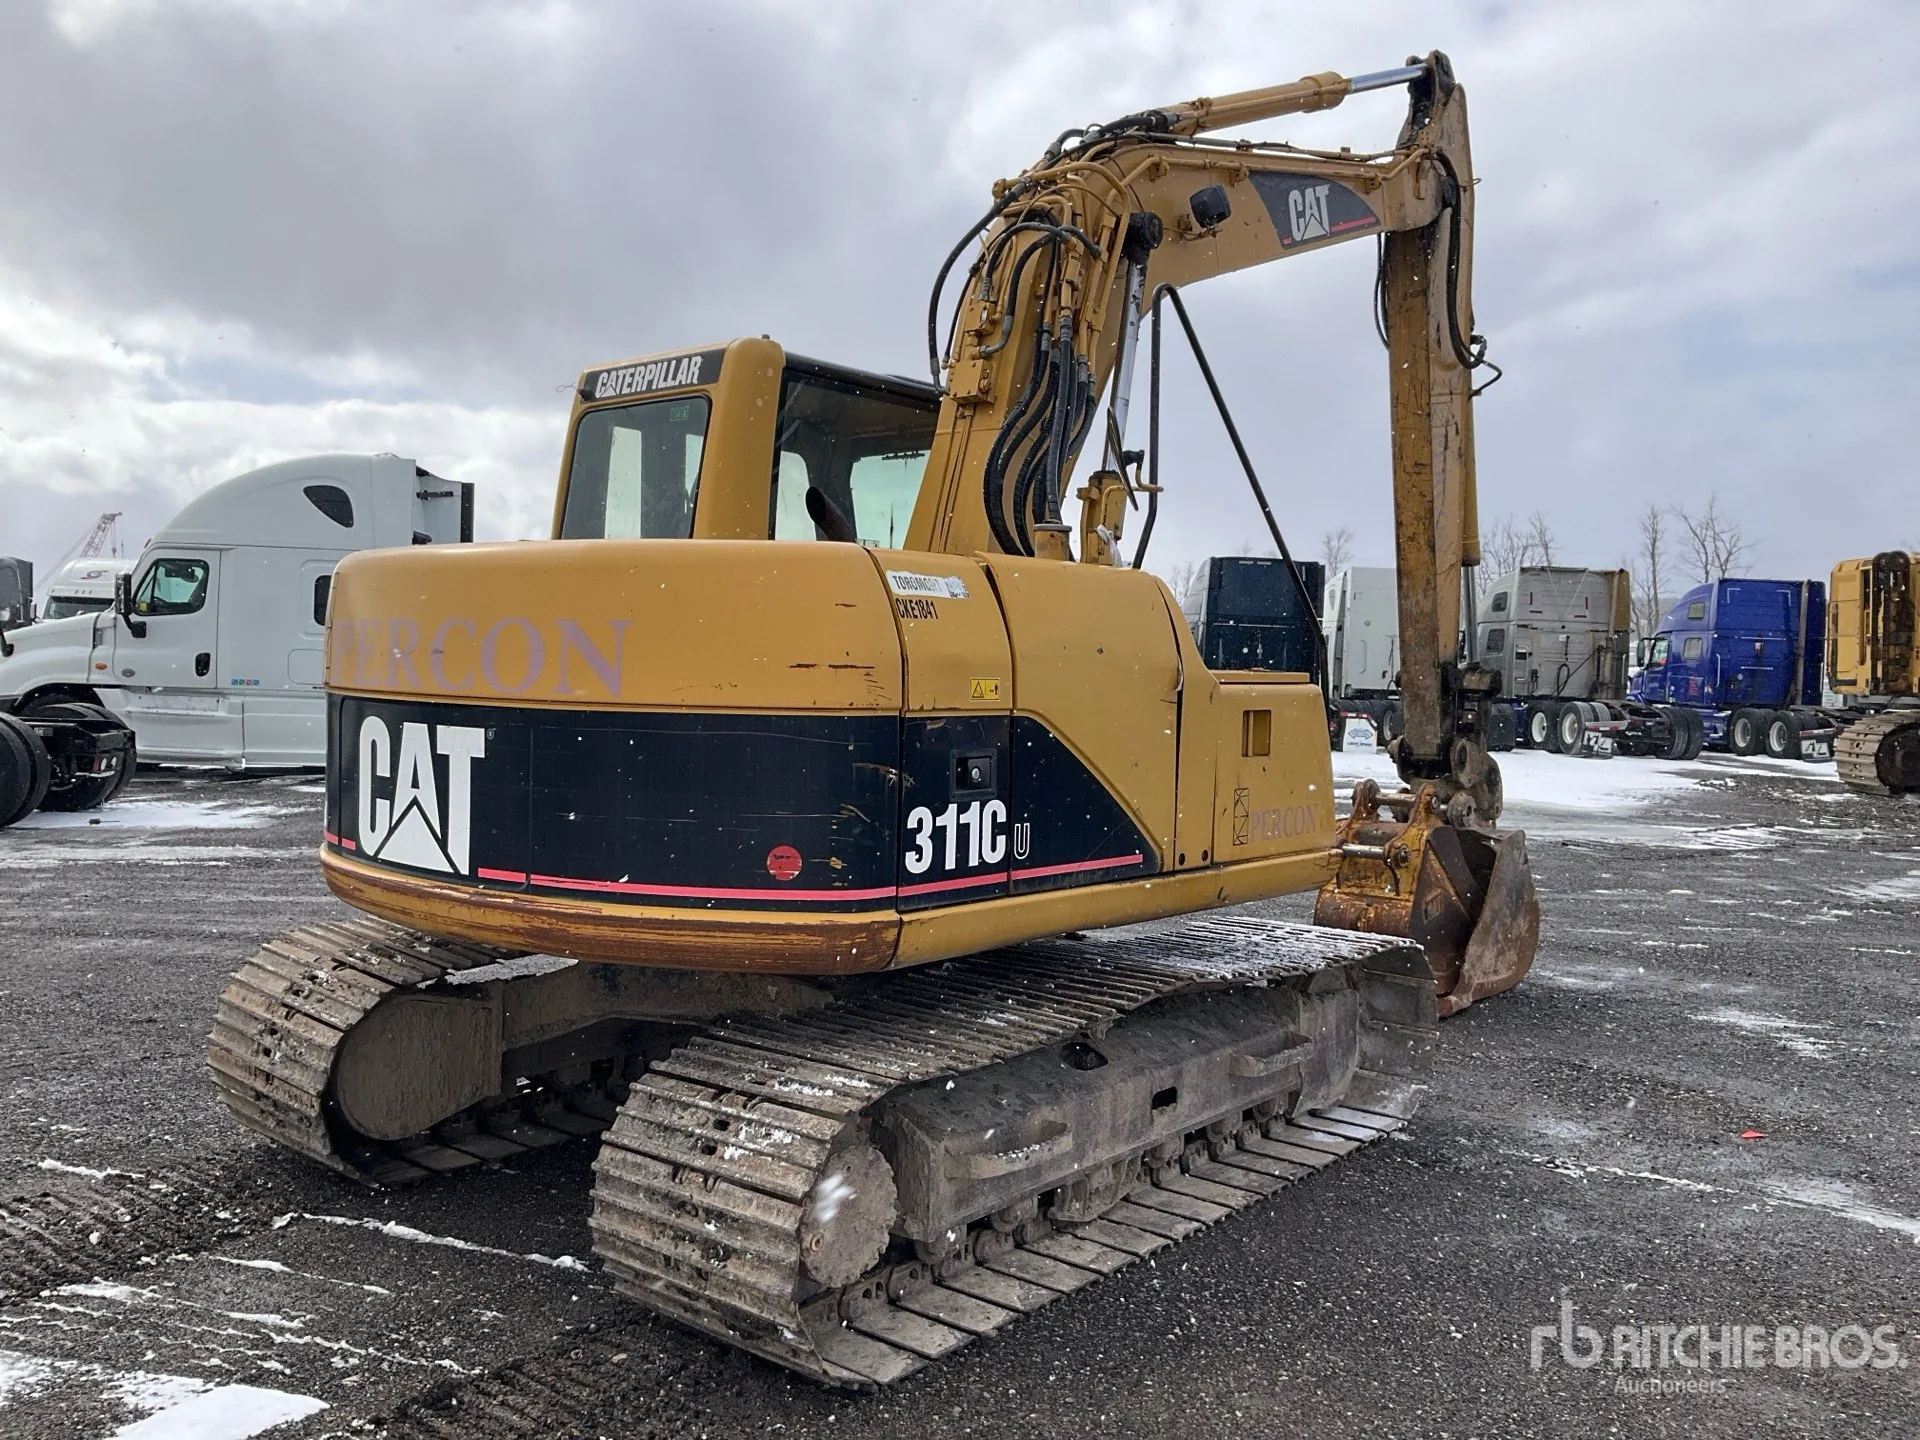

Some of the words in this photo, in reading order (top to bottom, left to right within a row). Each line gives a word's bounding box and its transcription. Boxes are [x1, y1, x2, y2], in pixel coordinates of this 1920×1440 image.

[1288, 185, 1330, 241] CAT
[595, 355, 701, 399] CATERPILLAR
[895, 598, 938, 619] CKE1841
[330, 616, 634, 698] PERCON
[358, 715, 486, 875] CAT
[1250, 803, 1318, 842] PERCON
[905, 799, 1007, 874] 311C
[1013, 822, 1031, 860] U
